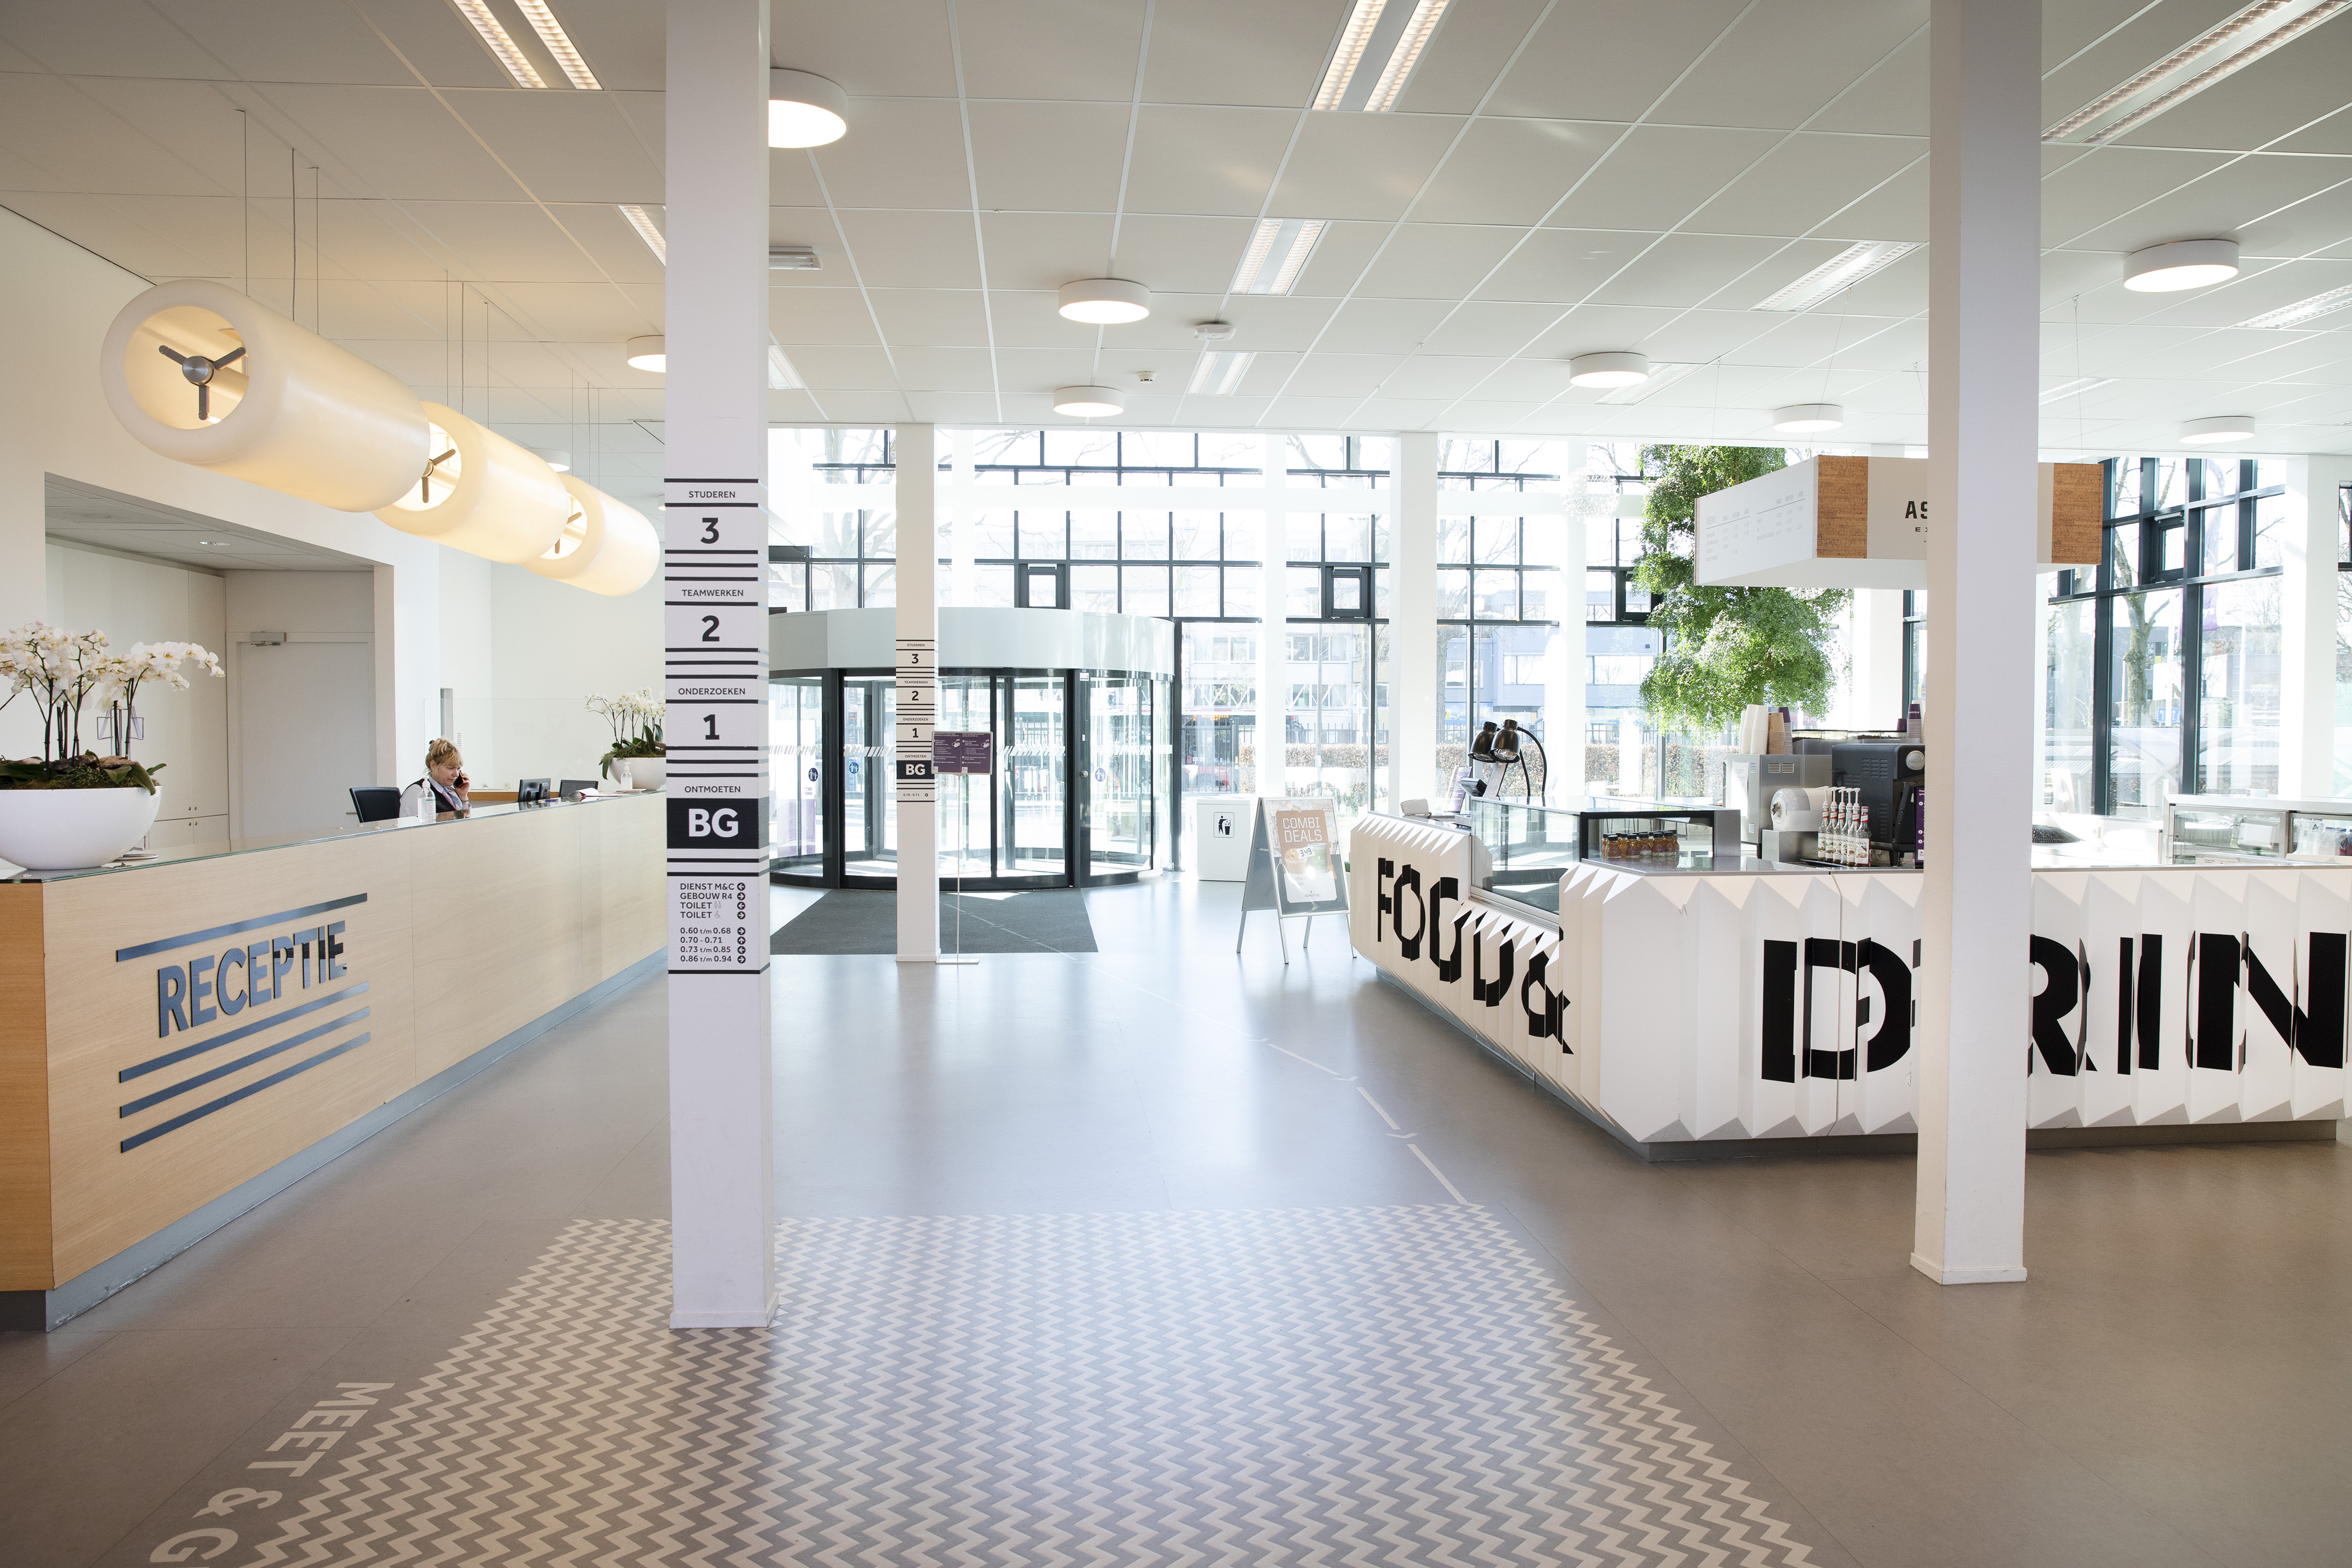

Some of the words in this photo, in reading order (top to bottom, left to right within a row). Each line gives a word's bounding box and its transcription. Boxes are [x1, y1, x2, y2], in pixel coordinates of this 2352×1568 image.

[688, 491, 736, 499] STUDEREN
[1905, 501, 1927, 519] AS
[700, 517, 719, 544] 3
[682, 589, 744, 597] TEAMWERKEN
[702, 615, 720, 642] 2
[912, 653, 919, 664] 3
[678, 688, 746, 696] ONDERZOEKEN
[912, 690, 919, 701] 2
[703, 714, 720, 740] 1
[912, 727, 919, 738] 1
[906, 764, 926, 776] BG
[688, 808, 739, 838] BG
[1283, 817, 1320, 829] COMBI
[1284, 829, 1322, 843] DEALS
[1300, 848, 1312, 857] 3.49
[680, 883, 713, 891] DIENST
[714, 883, 734, 891] M&C
[1377, 858, 1514, 1007] FOOD
[158, 920, 347, 1038] RECEPTIE
[246, 1382, 396, 1477] MEET
[192, 1487, 283, 1518] &
[150, 1527, 239, 1568] G
